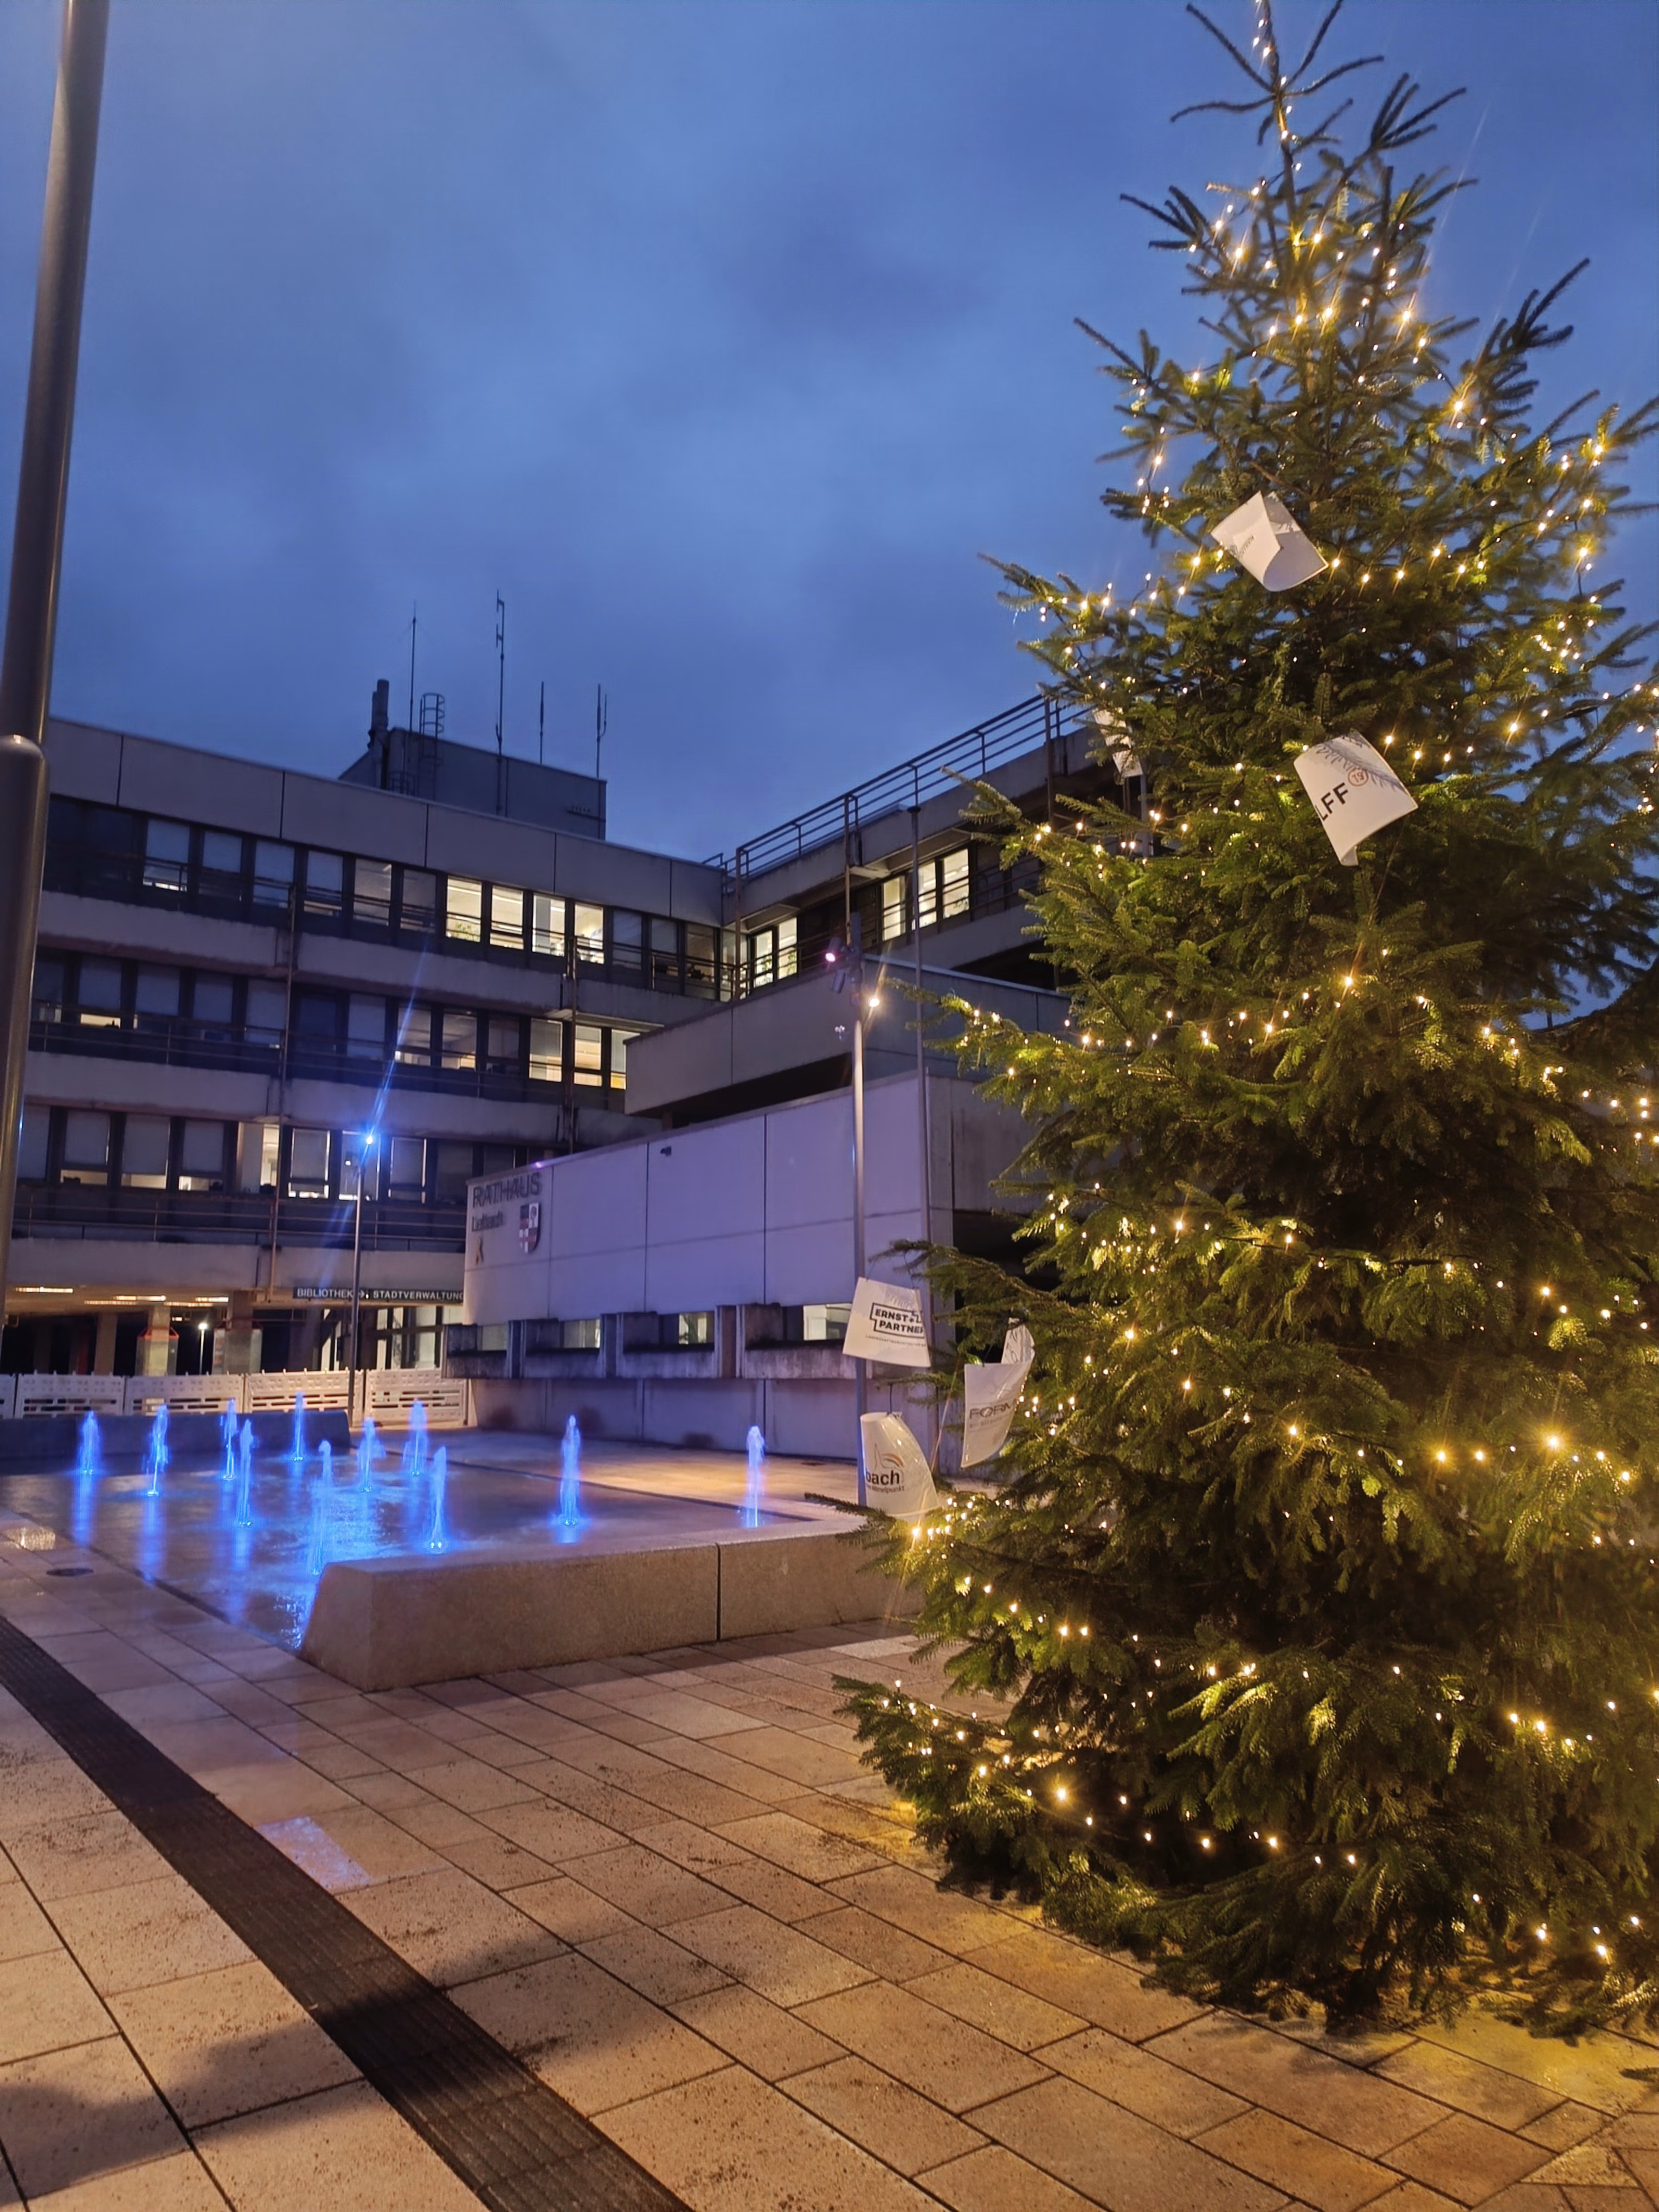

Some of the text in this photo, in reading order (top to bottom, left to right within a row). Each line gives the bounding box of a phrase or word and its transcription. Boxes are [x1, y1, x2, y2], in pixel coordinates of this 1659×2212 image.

[473, 1173, 542, 1208] RATHAUS
[297, 1288, 463, 1301] BIBLIOTHEK STADTVERWALTUNG
